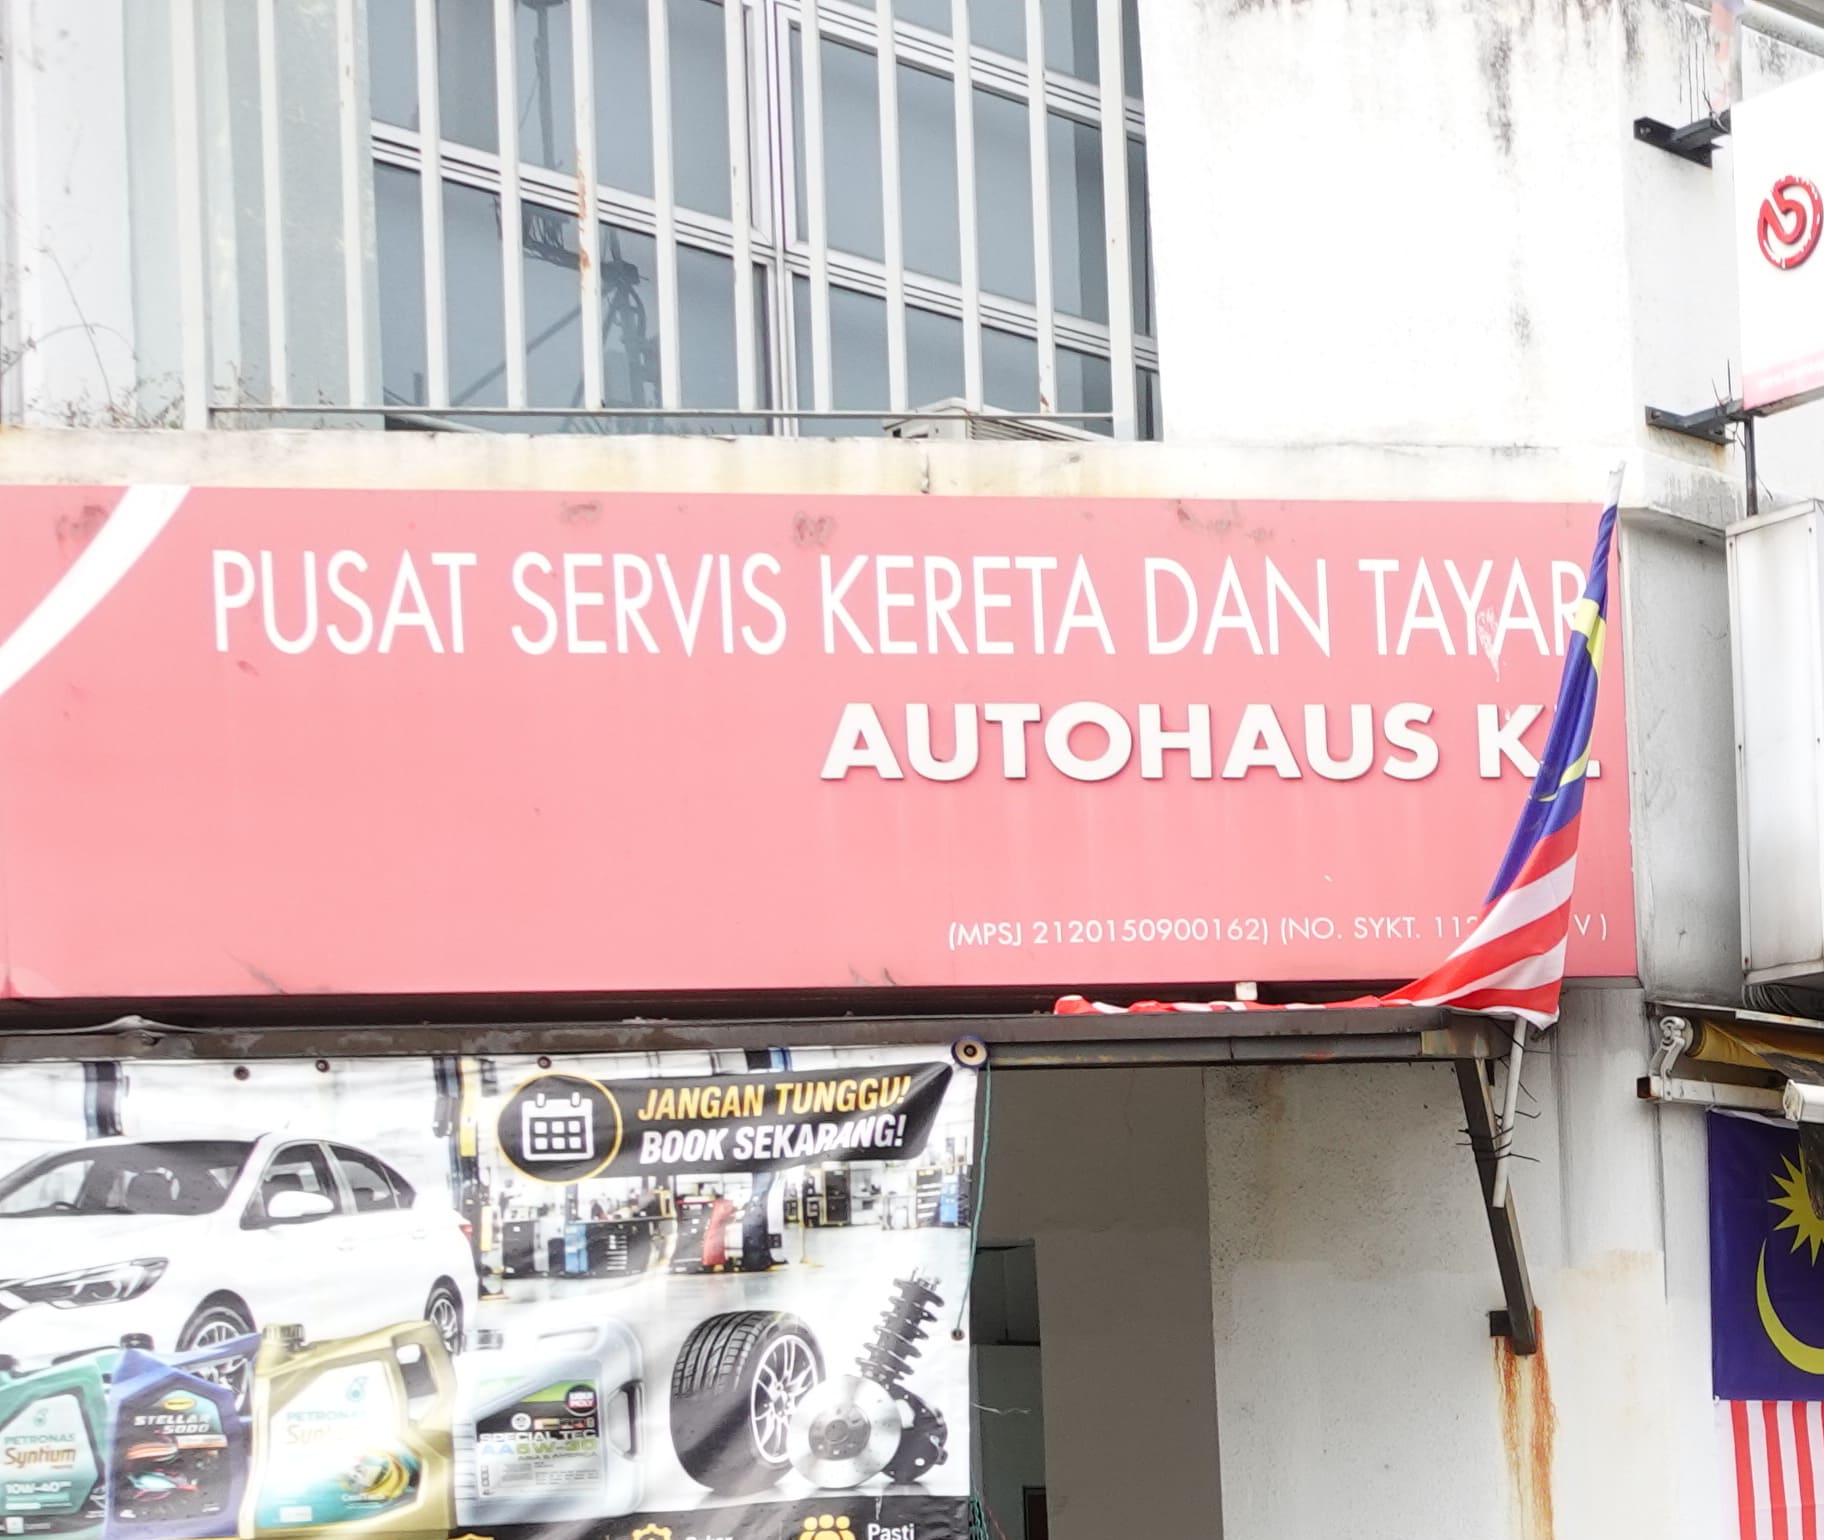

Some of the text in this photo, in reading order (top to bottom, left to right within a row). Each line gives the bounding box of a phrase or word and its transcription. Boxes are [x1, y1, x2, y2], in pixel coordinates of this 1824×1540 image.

[212, 549, 1588, 657] PUSAT SERVIS KERETA DAN TAYAR
[820, 701, 1441, 782] AUTOHAUS
[948, 918, 1023, 953] (MPSJ
[1031, 916, 1269, 948] 2120150900162)
[1280, 914, 1343, 946] (NO.
[1354, 913, 1422, 943] SYKT.
[637, 1076, 911, 1122] JANGAN TUNGGU!
[640, 1114, 906, 1164] BOOK SEKARANG!
